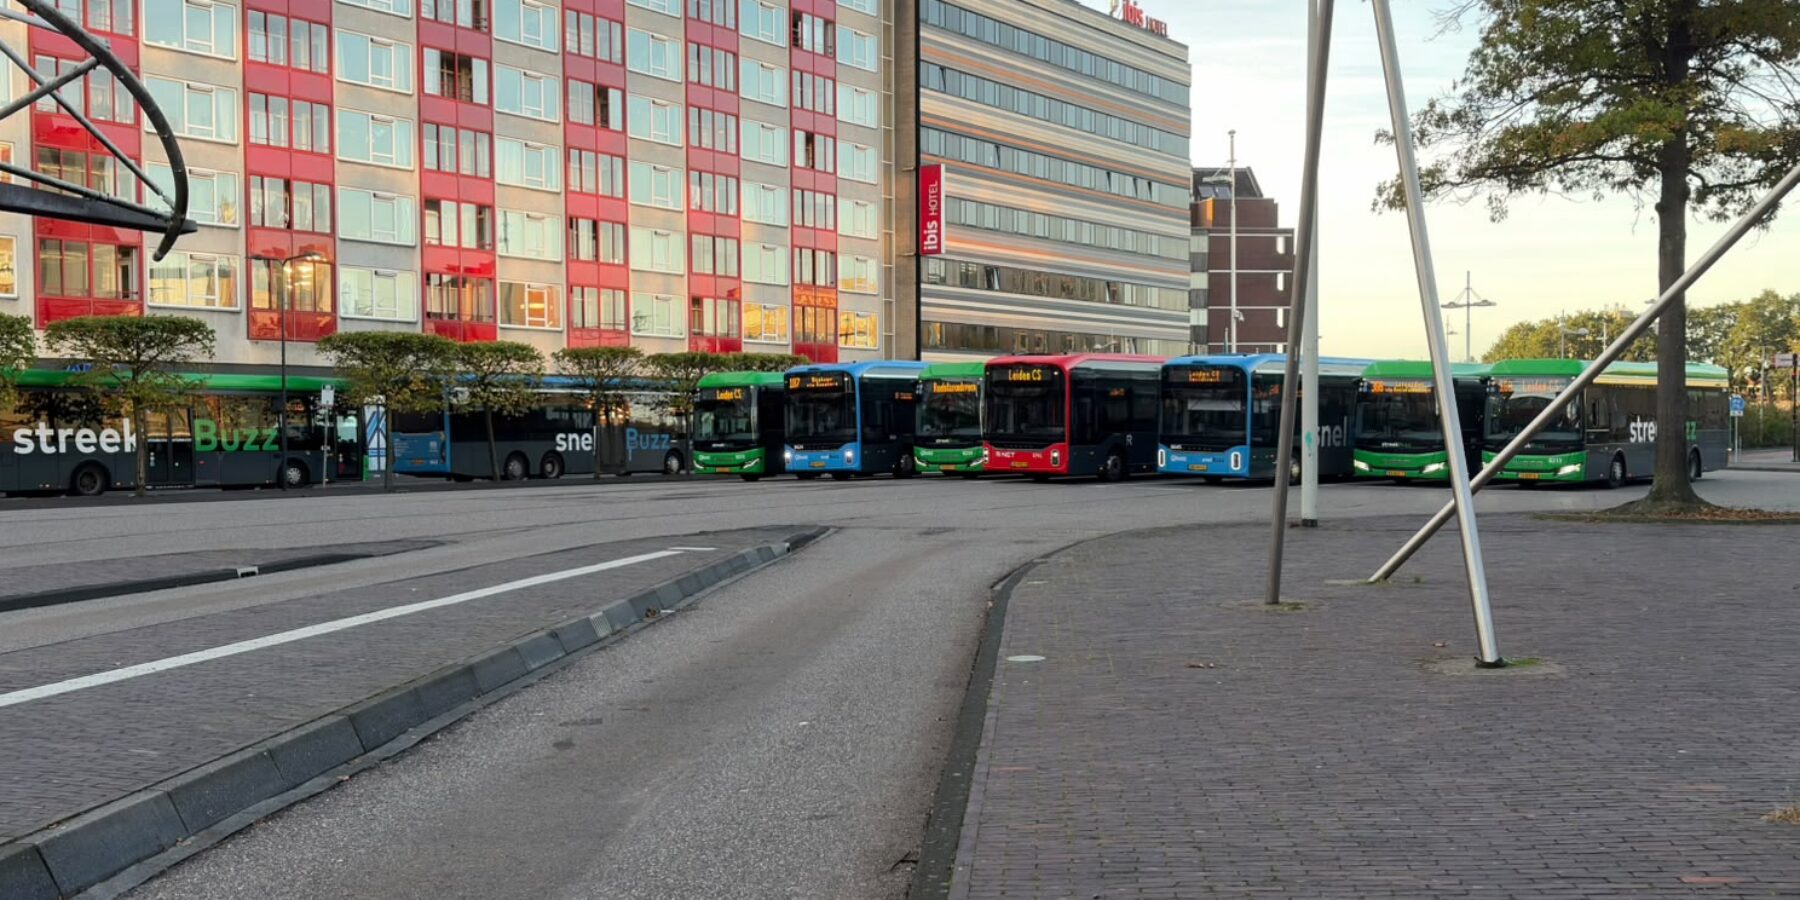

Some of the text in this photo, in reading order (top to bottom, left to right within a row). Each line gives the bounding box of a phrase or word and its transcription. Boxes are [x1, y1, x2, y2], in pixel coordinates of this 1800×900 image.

[1122, 0, 1168, 38] ibis HOTEL
[923, 180, 938, 250] ibis HOTEL
[1008, 369, 1042, 381] Leiden CS
[13, 418, 279, 454] streek Buzz
[626, 428, 670, 450] Buzz
[1630, 415, 1658, 444] stre
